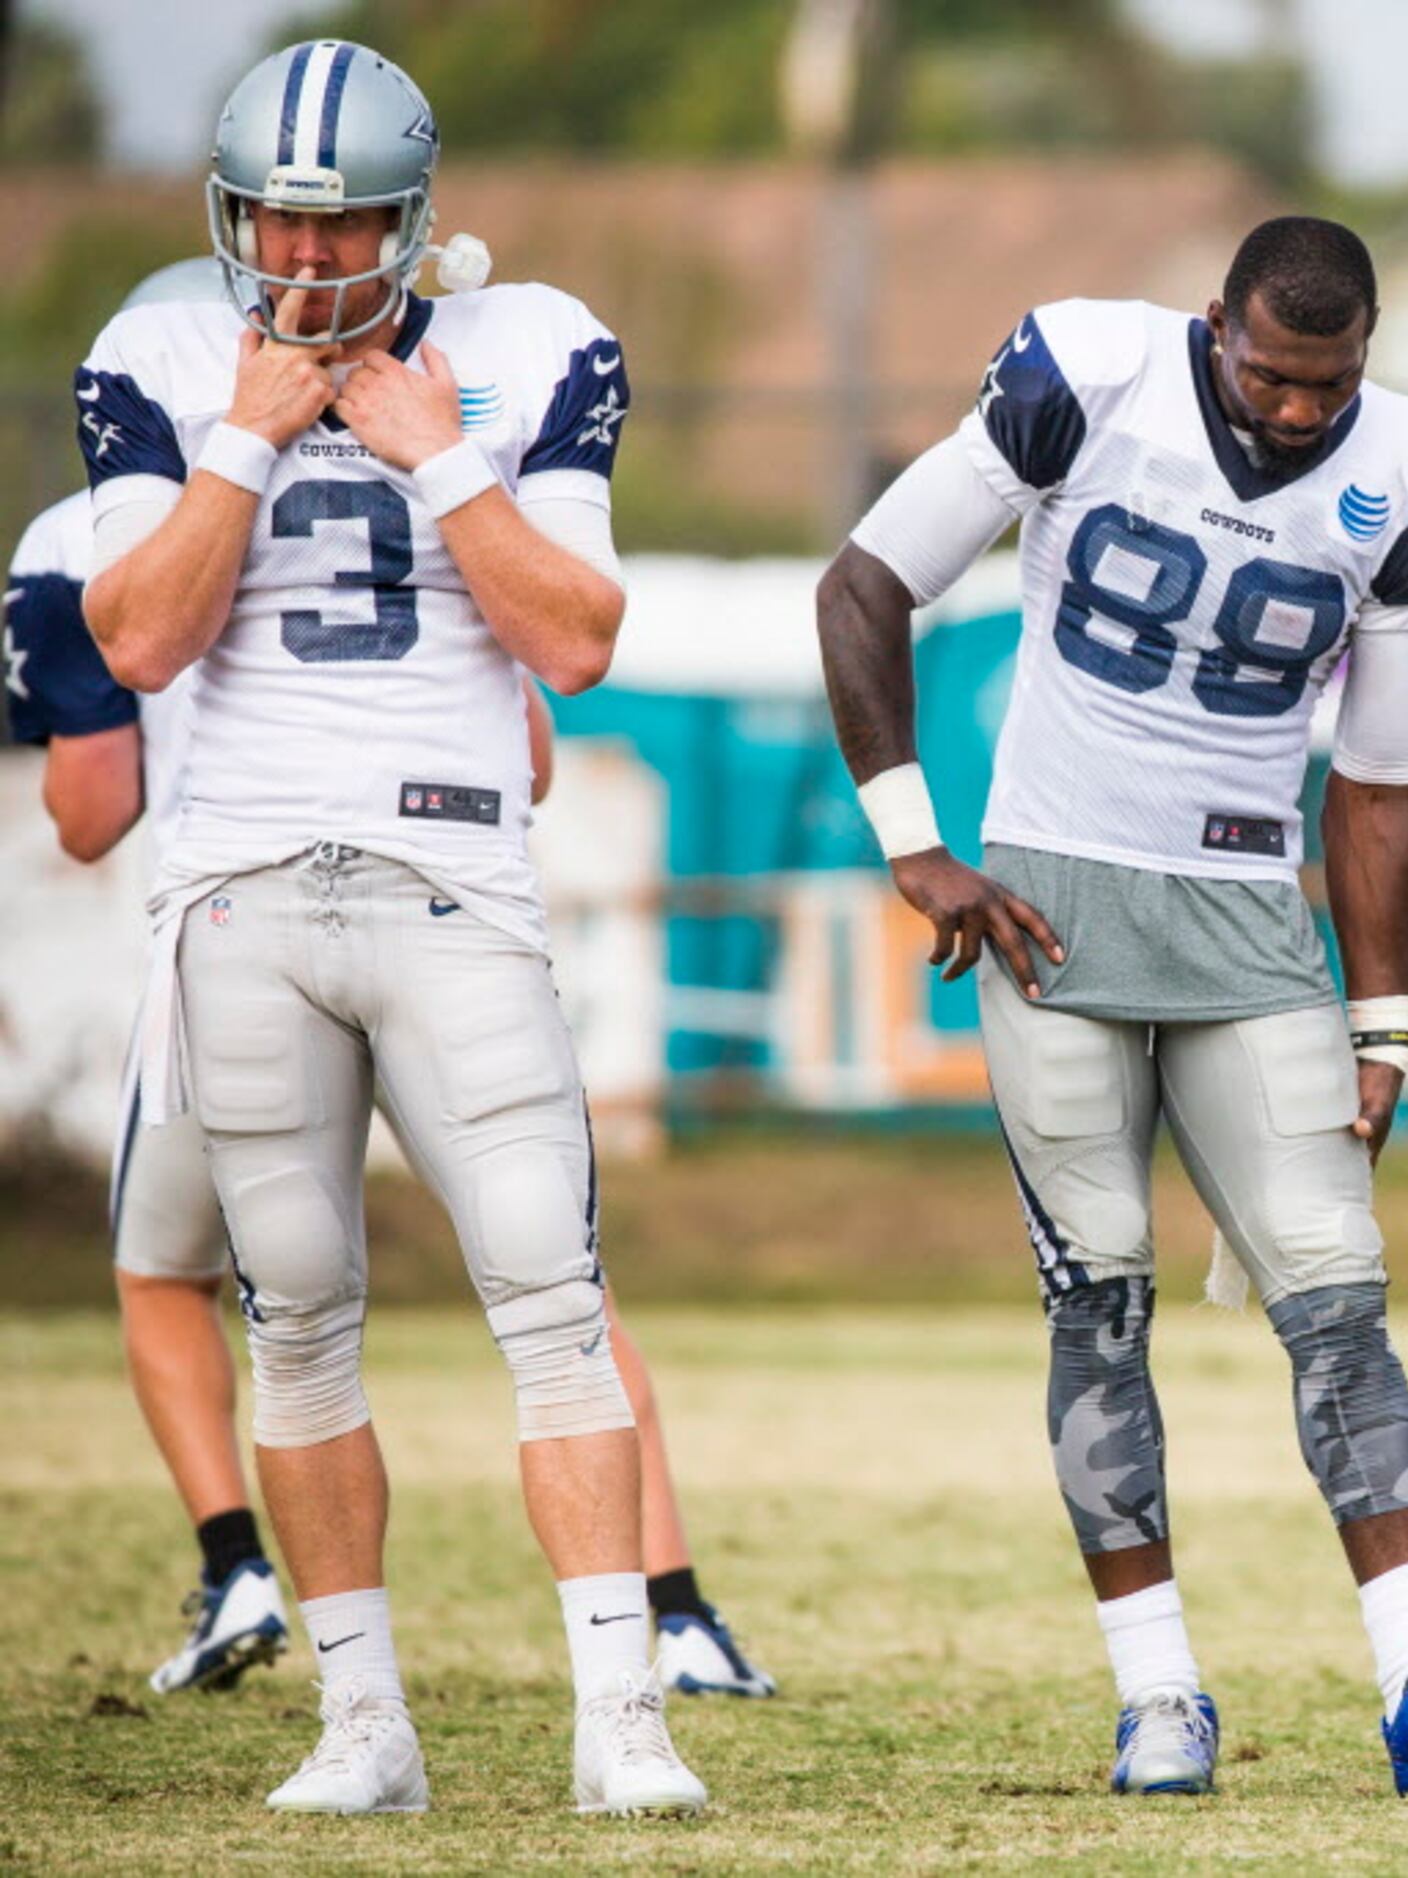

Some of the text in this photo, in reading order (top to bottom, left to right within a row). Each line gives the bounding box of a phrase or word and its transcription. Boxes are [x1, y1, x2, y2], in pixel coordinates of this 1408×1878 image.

[271, 478, 419, 663] 3
[1053, 501, 1345, 718] 88
[1200, 507, 1275, 544] COWBOYS
